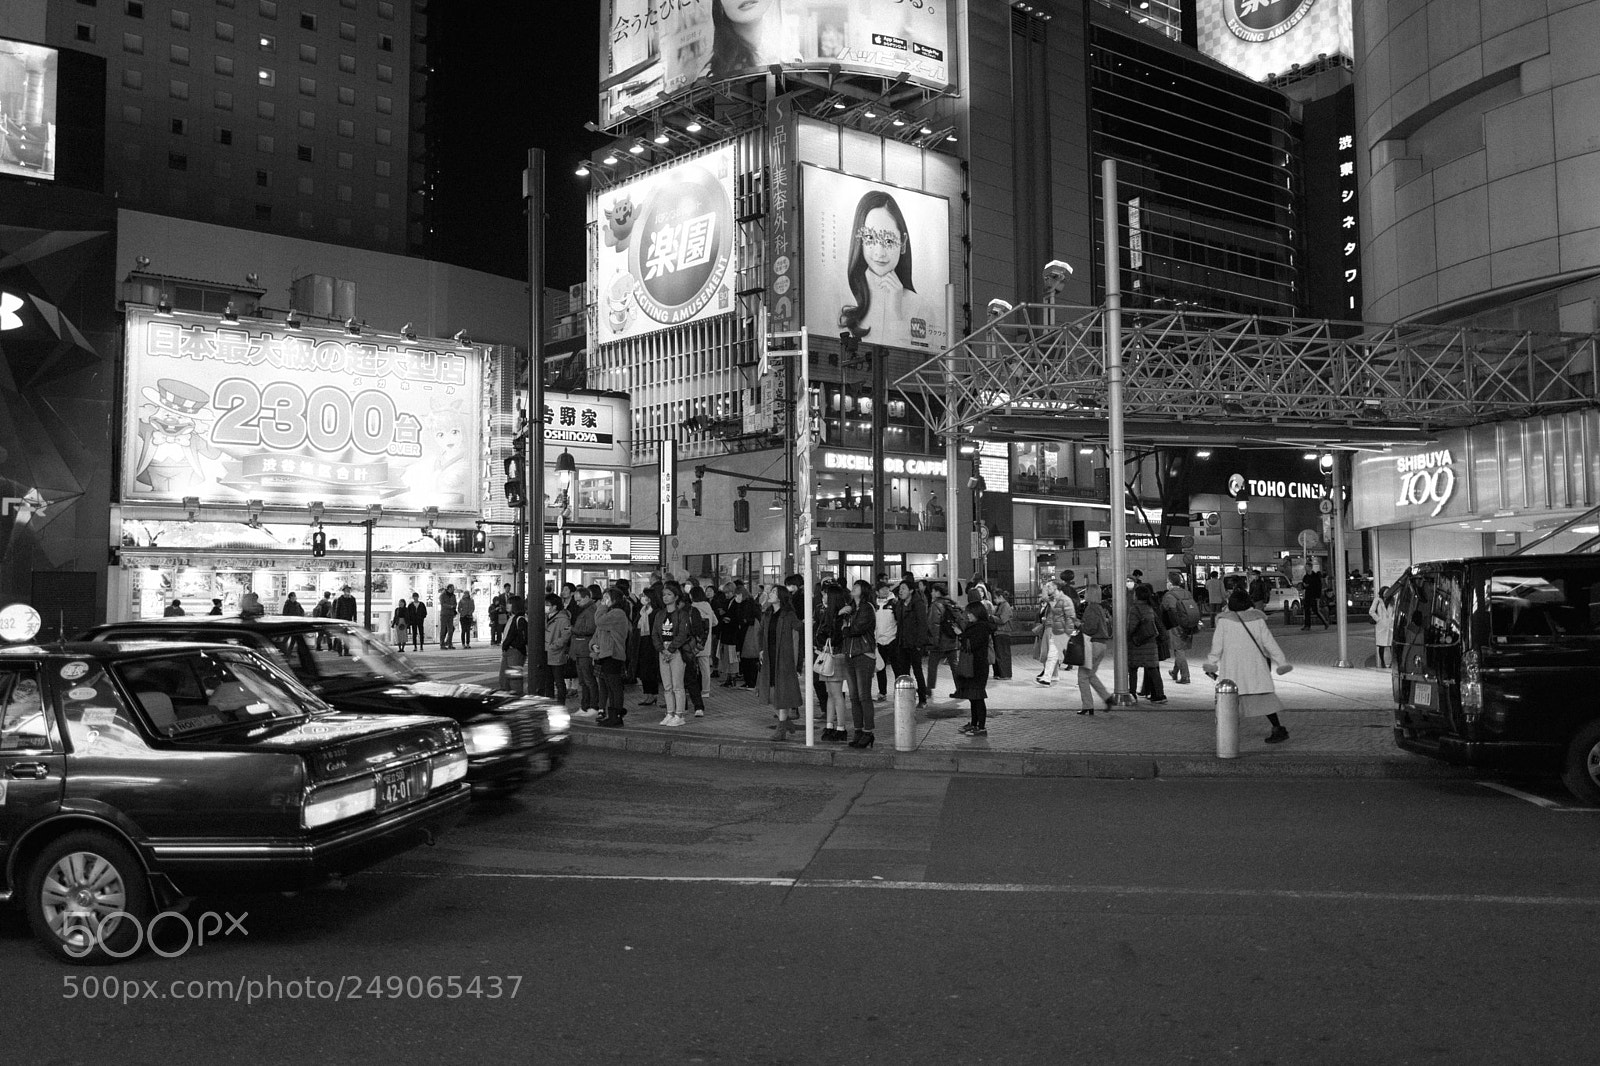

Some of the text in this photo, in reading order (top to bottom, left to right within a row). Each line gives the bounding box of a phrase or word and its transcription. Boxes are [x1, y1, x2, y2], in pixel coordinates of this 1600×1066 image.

[1228, 19, 1264, 41] EXCITING
[836, 47, 945, 81] ハッピーメール
[773, 125, 789, 256] 品川美容外科
[1338, 135, 1357, 310] 渋東シネタワー
[644, 211, 717, 281] 楽園
[633, 255, 728, 323] EXCITING AMUSEMENT
[147, 321, 467, 386] 日本最大級の超大型店
[354, 377, 456, 396] メガホール
[544, 430, 598, 442] OSHINOYA
[387, 443, 422, 458] OVER
[825, 452, 905, 473] EXCELOR
[1397, 449, 1452, 473] SHIBUYA
[1248, 479, 1286, 498] TOHO
[1395, 466, 1454, 517] 109
[574, 538, 613, 552] 吉野家
[24, 608, 40, 636] 大和
